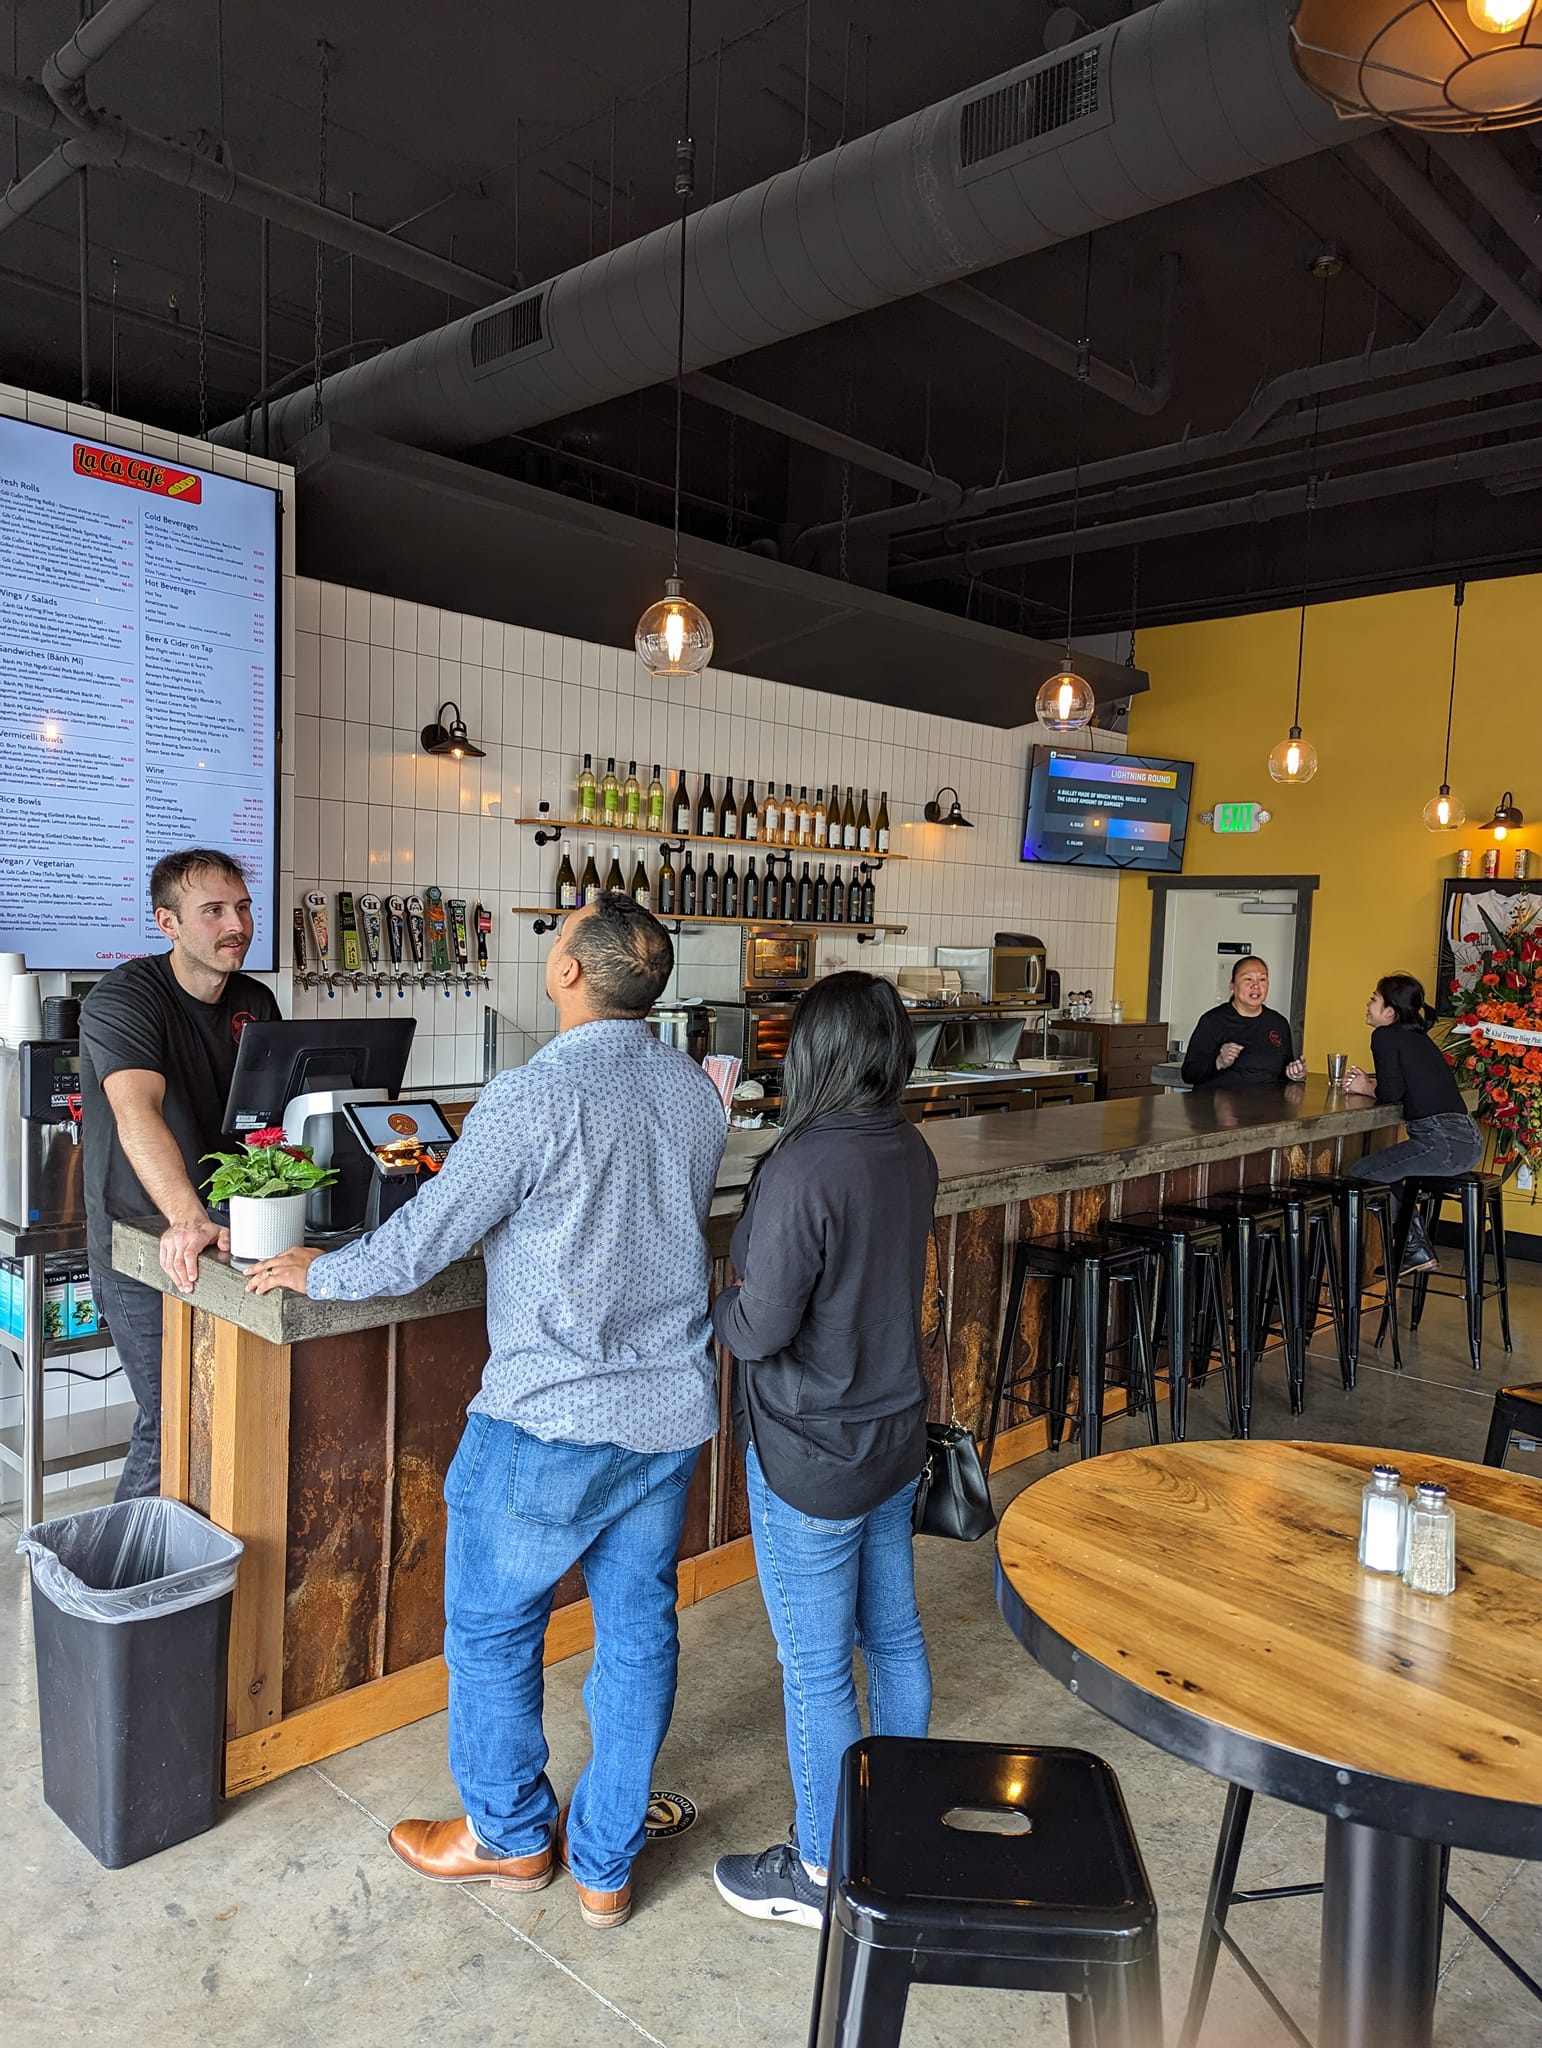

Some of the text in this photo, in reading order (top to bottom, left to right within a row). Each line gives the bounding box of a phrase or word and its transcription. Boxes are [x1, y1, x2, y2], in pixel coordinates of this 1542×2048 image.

[76, 446, 97, 473] La
[127, 460, 164, 488] Café
[0, 476, 39, 493] resh Rolls
[144, 511, 198, 531] Cold Beverages
[144, 578, 196, 595] Hot Beverages
[31, 594, 57, 606] Salads
[145, 634, 161, 643] Beer
[170, 638, 188, 648] Cider
[201, 644, 213, 654] Tap
[145, 765, 164, 774] Wine
[1111, 770, 1170, 784] LIGHTNING ROUND
[17, 797, 41, 805] Bowls
[1221, 805, 1253, 831] EXIT
[33, 859, 74, 868] Vegetarian
[648, 1793, 694, 1814] APROOM
